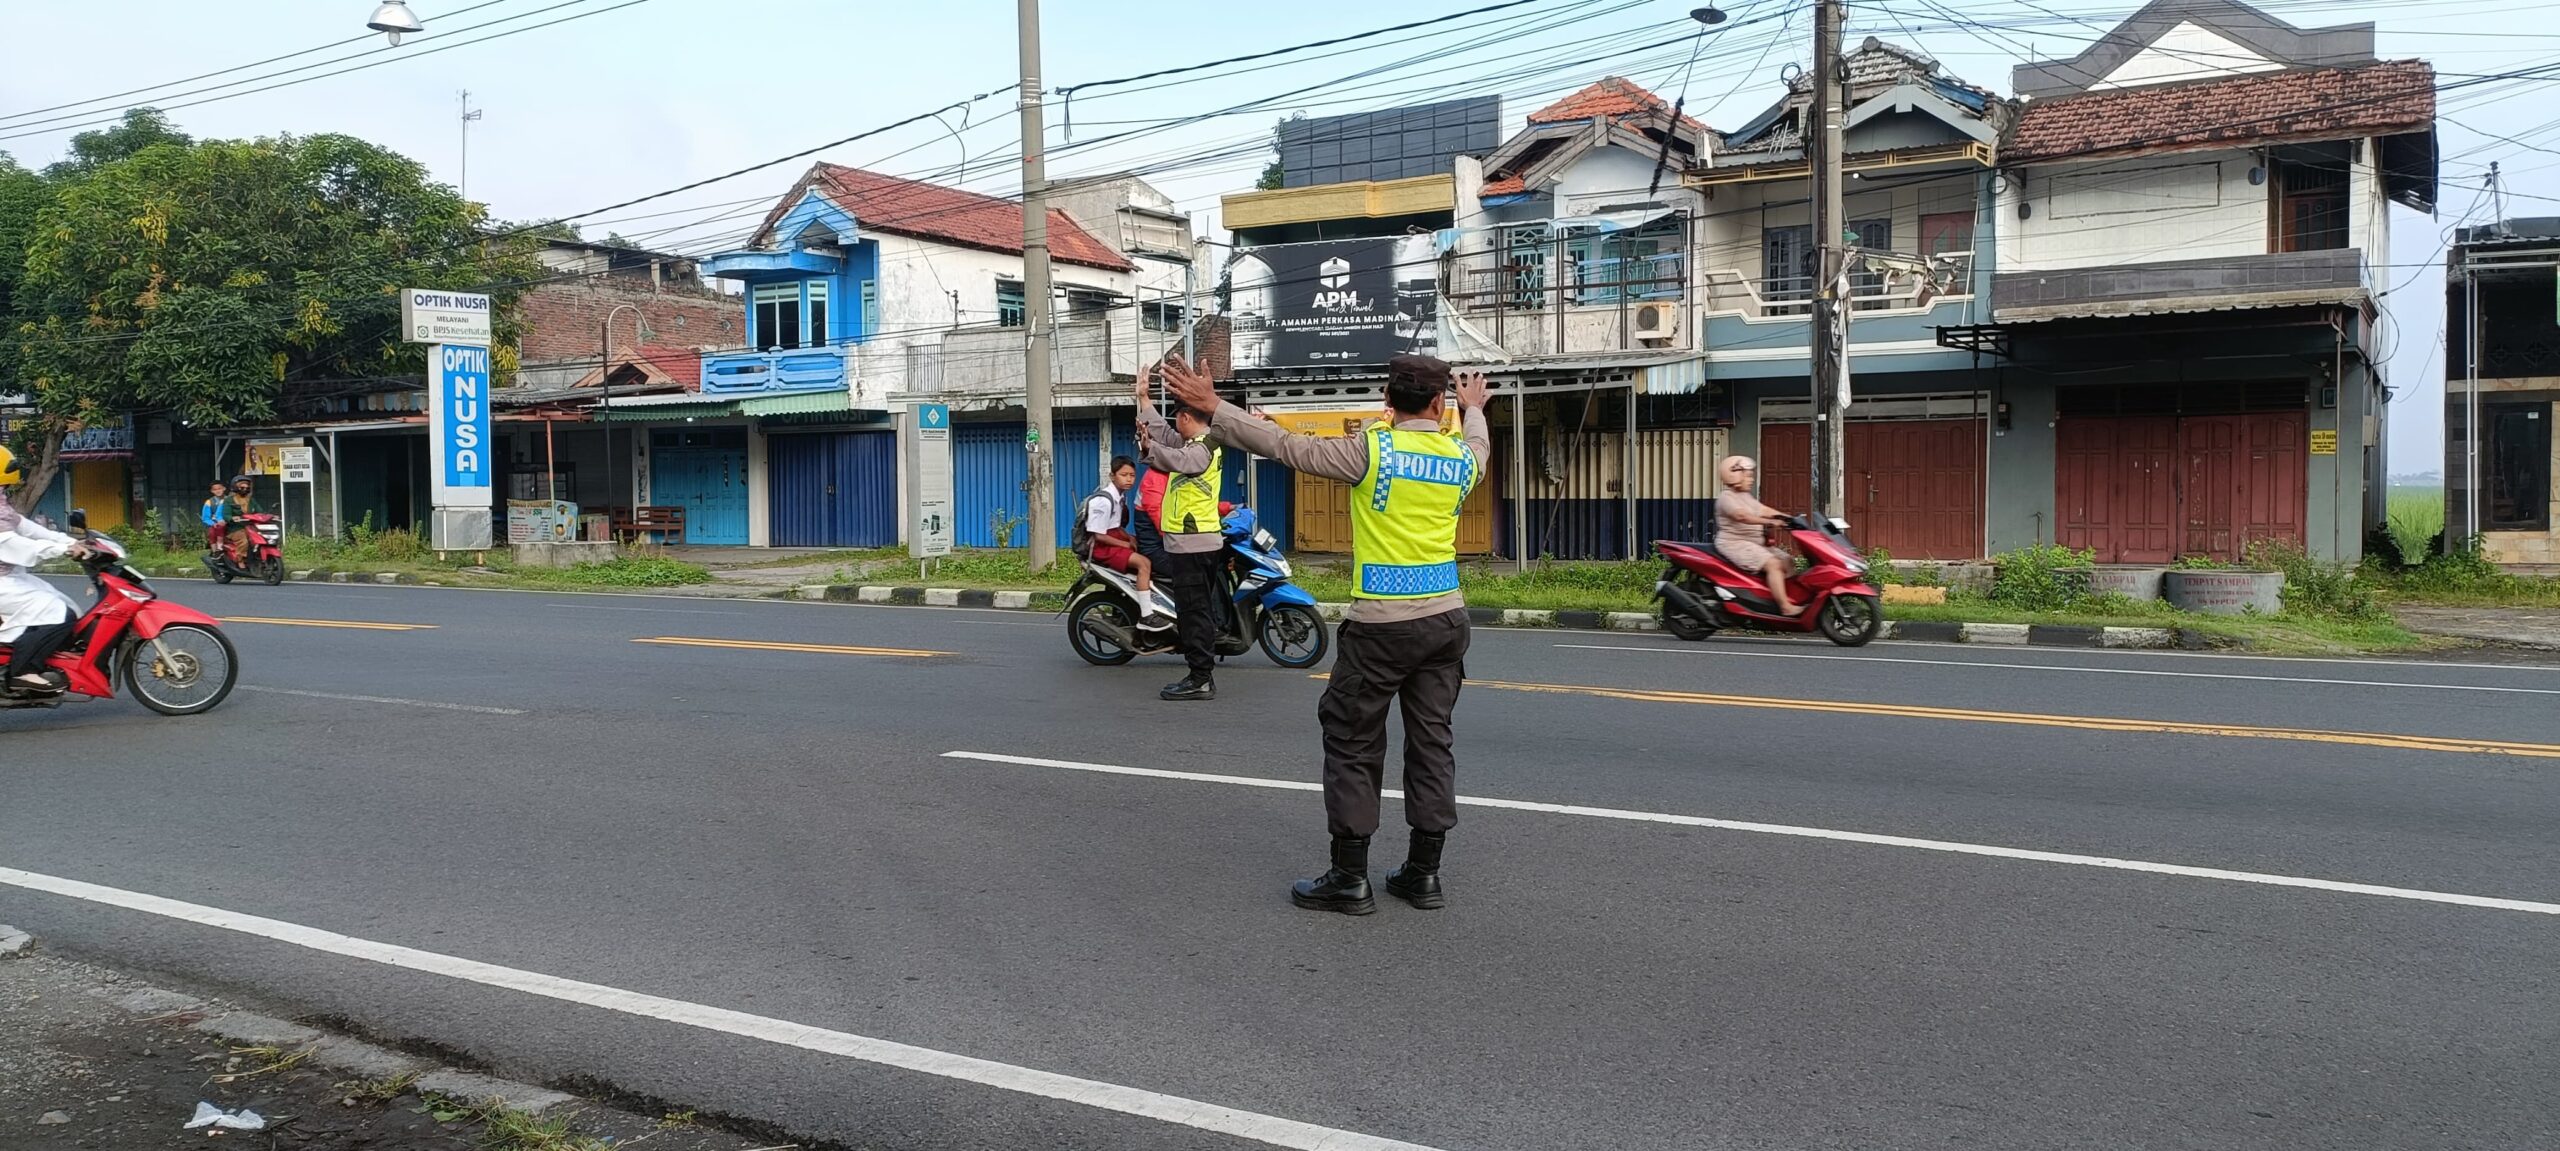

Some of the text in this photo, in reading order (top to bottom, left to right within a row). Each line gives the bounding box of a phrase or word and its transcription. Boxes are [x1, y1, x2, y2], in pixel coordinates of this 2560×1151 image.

[414, 294, 487, 309] OPTIK NUSA
[1311, 290, 1357, 309] APM
[433, 325, 489, 336] BPJS Kesehatan
[1265, 320, 1279, 328] PT.
[1281, 318, 1319, 327] AMANAH
[1321, 316, 1361, 325] PERKASA
[444, 348, 486, 374] OPTIK
[455, 375, 478, 472] NUSA
[1395, 454, 1463, 483] POLISI
[2184, 577, 2215, 586] TEMPAT
